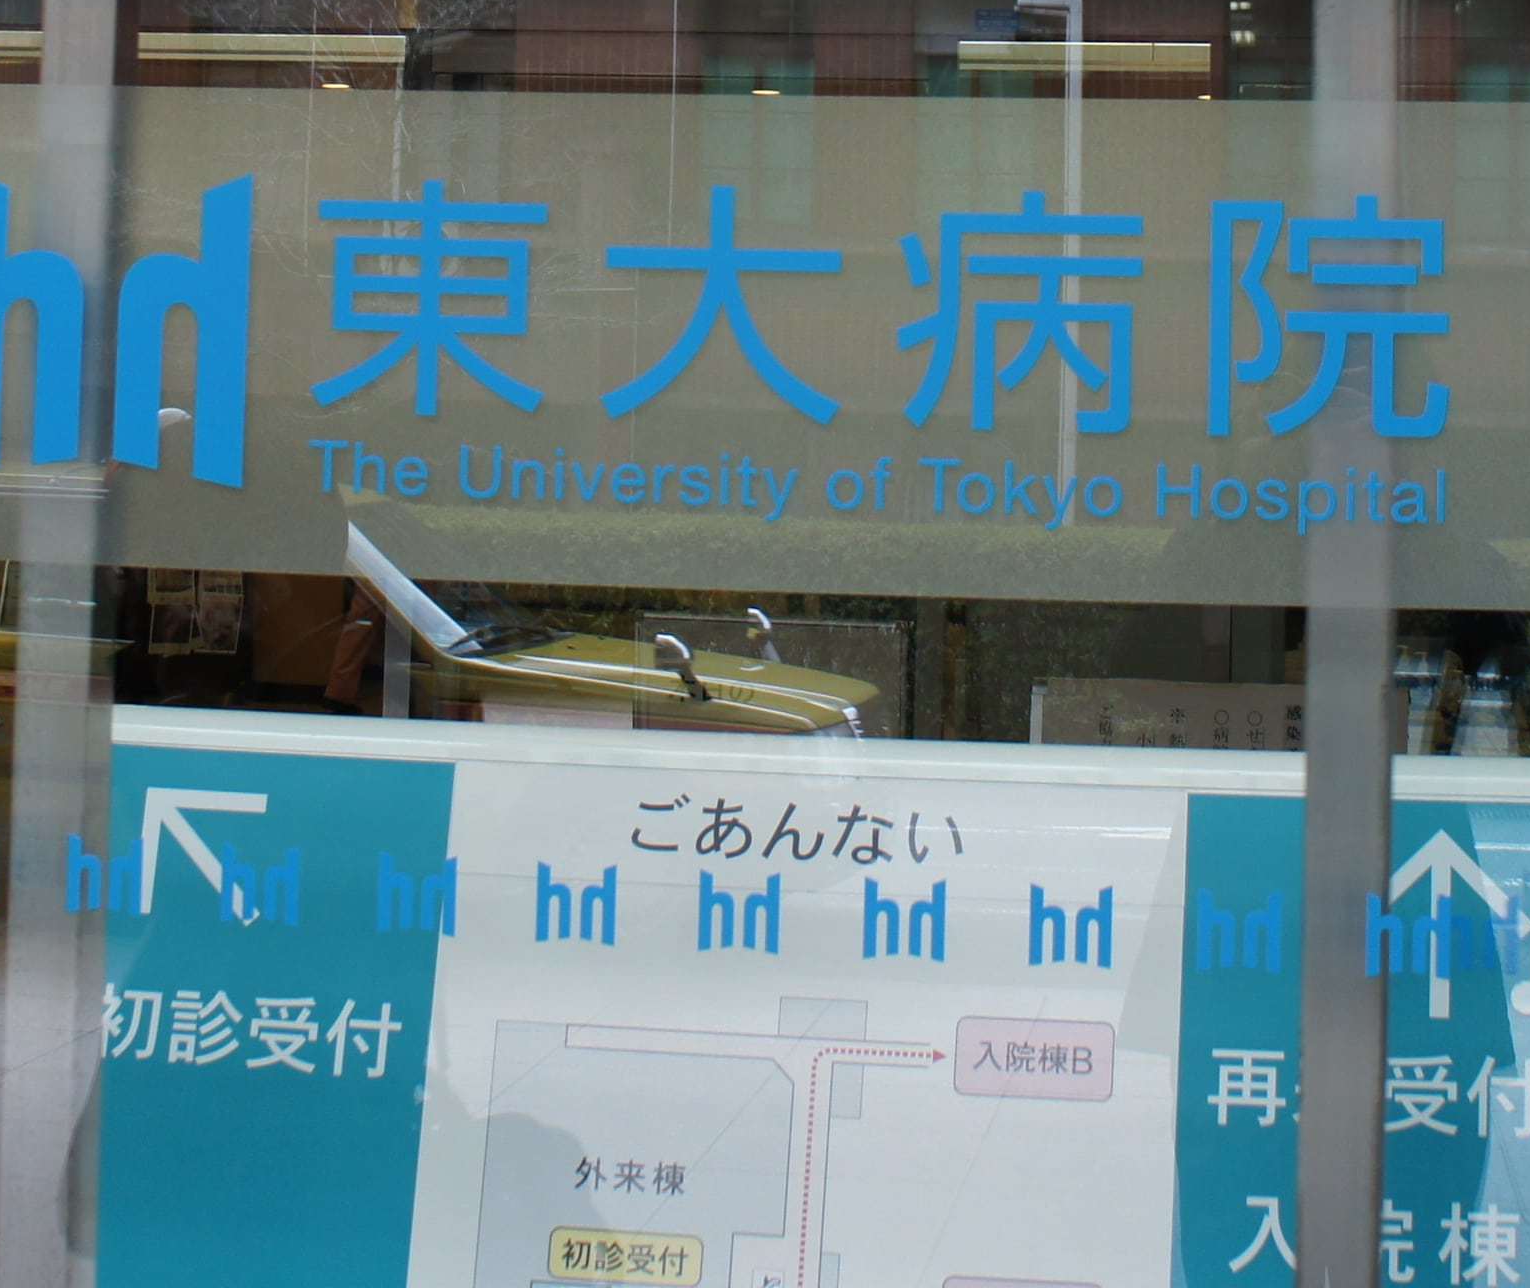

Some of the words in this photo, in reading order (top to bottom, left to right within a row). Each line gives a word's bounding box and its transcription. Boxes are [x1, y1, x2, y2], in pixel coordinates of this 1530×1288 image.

[310, 180, 1452, 441] 東大病院
[309, 439, 429, 497] The
[459, 444, 798, 522] University
[826, 457, 893, 512] of
[919, 457, 1125, 531] Tokyo
[1156, 465, 1448, 535] Hospital
[629, 795, 963, 867] ごあんない
[101, 982, 403, 1079] 初診受付
[972, 1042, 1093, 1076] 入院棟B
[574, 1156, 687, 1197] 外来棟
[562, 1238, 689, 1277] 初診受付
